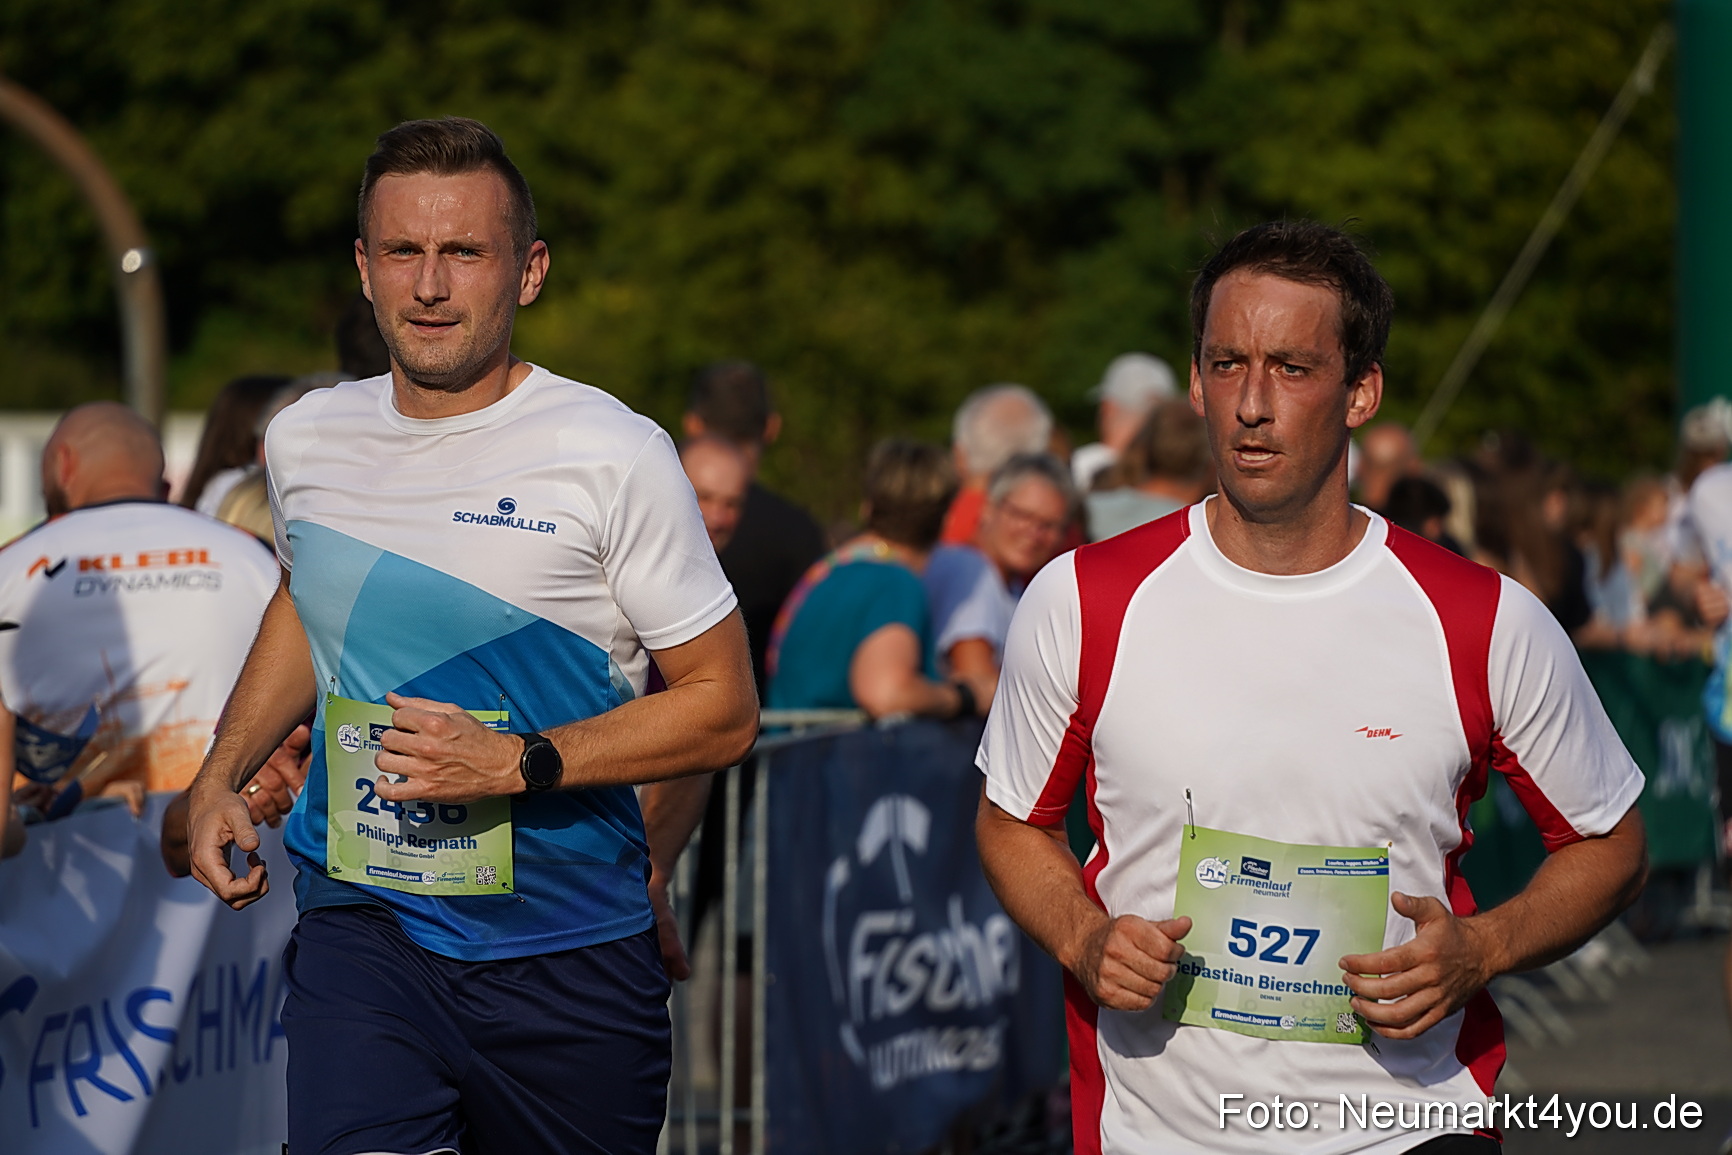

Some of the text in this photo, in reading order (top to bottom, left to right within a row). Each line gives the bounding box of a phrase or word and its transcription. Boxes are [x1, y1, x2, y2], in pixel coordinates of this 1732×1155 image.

[452, 511, 557, 534] SCHABMÜLLER
[77, 548, 222, 573] KLEBL
[74, 570, 223, 598] DYNAMICS
[1366, 728, 1392, 738] DEHN
[356, 822, 477, 852] Philipp Regnath
[390, 849, 418, 858] Schabmüller
[368, 867, 420, 882] firmenlauf.bayern
[1230, 875, 1292, 892] Firmenlauf
[1253, 889, 1290, 898] neumarkt
[1228, 918, 1320, 966] 527
[1214, 1010, 1278, 1026] firmenlauf.bayern
